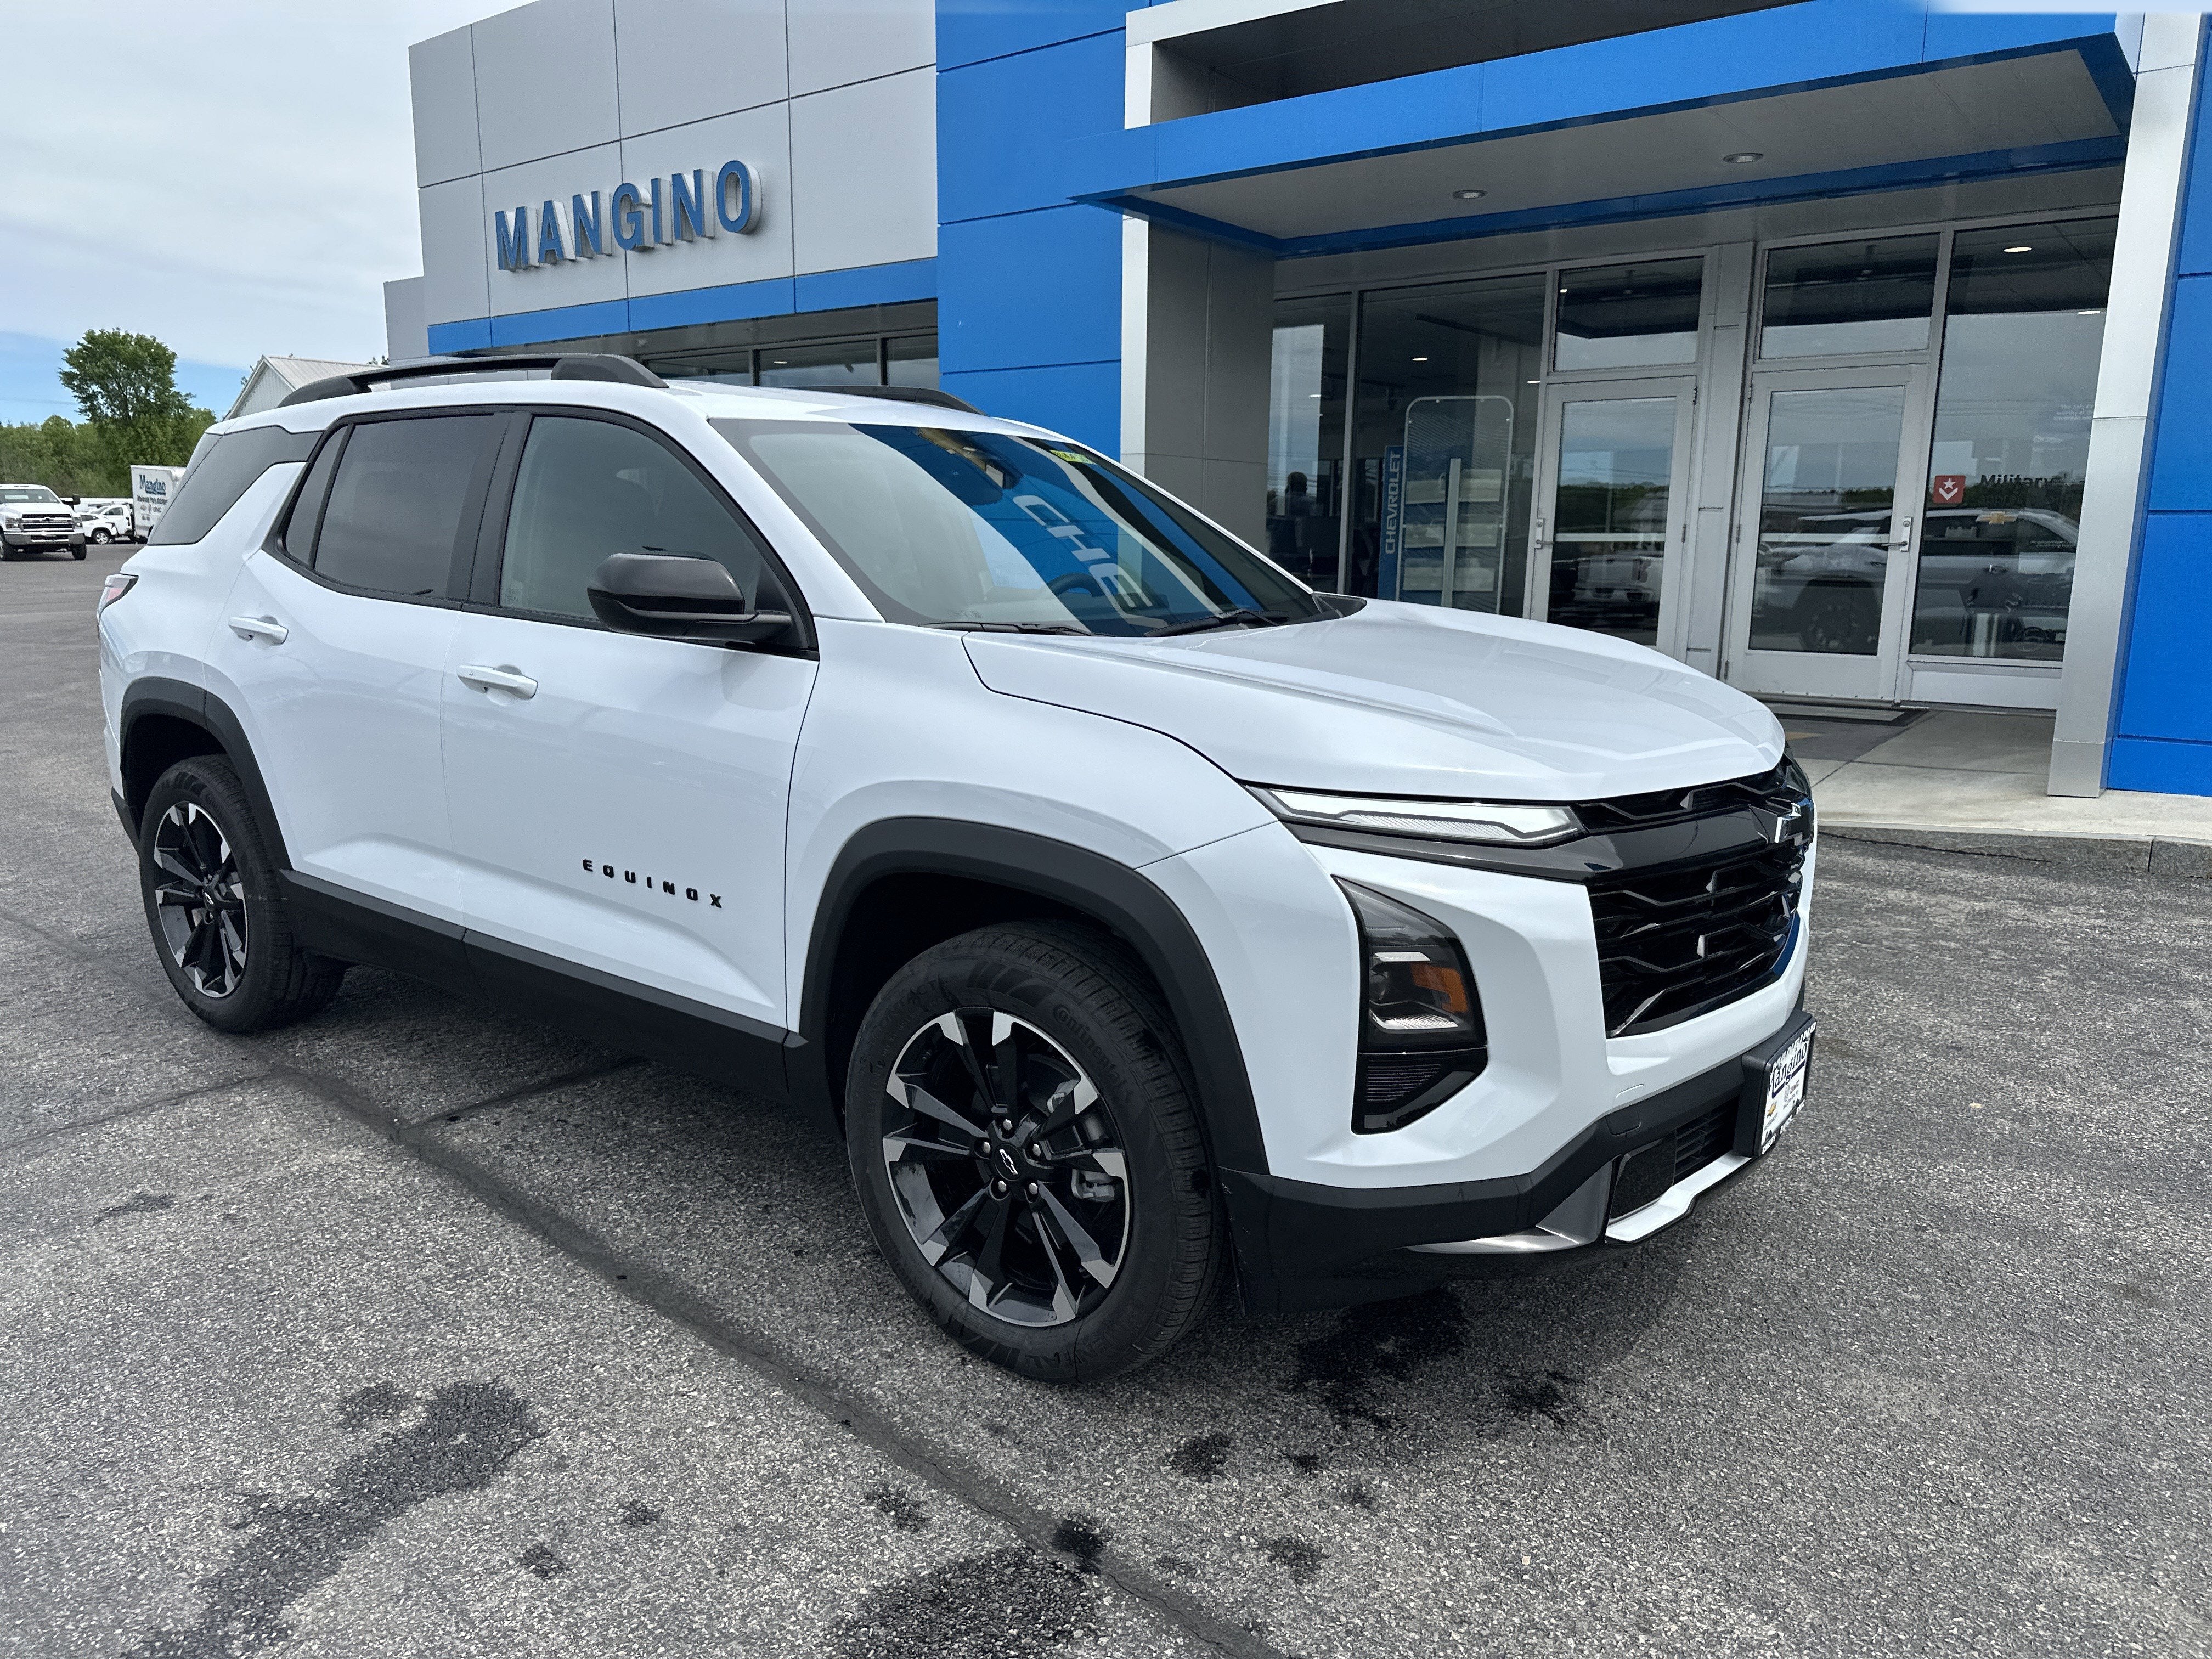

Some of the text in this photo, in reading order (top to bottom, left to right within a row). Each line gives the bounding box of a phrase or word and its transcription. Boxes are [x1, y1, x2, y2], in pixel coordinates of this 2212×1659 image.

[495, 160, 761, 271] MANGINO
[139, 475, 166, 494] Mangino
[1385, 450, 1401, 554] CHEVROLET
[583, 859, 722, 909] EQUINOX
[1053, 1004, 1127, 1088] Continental
